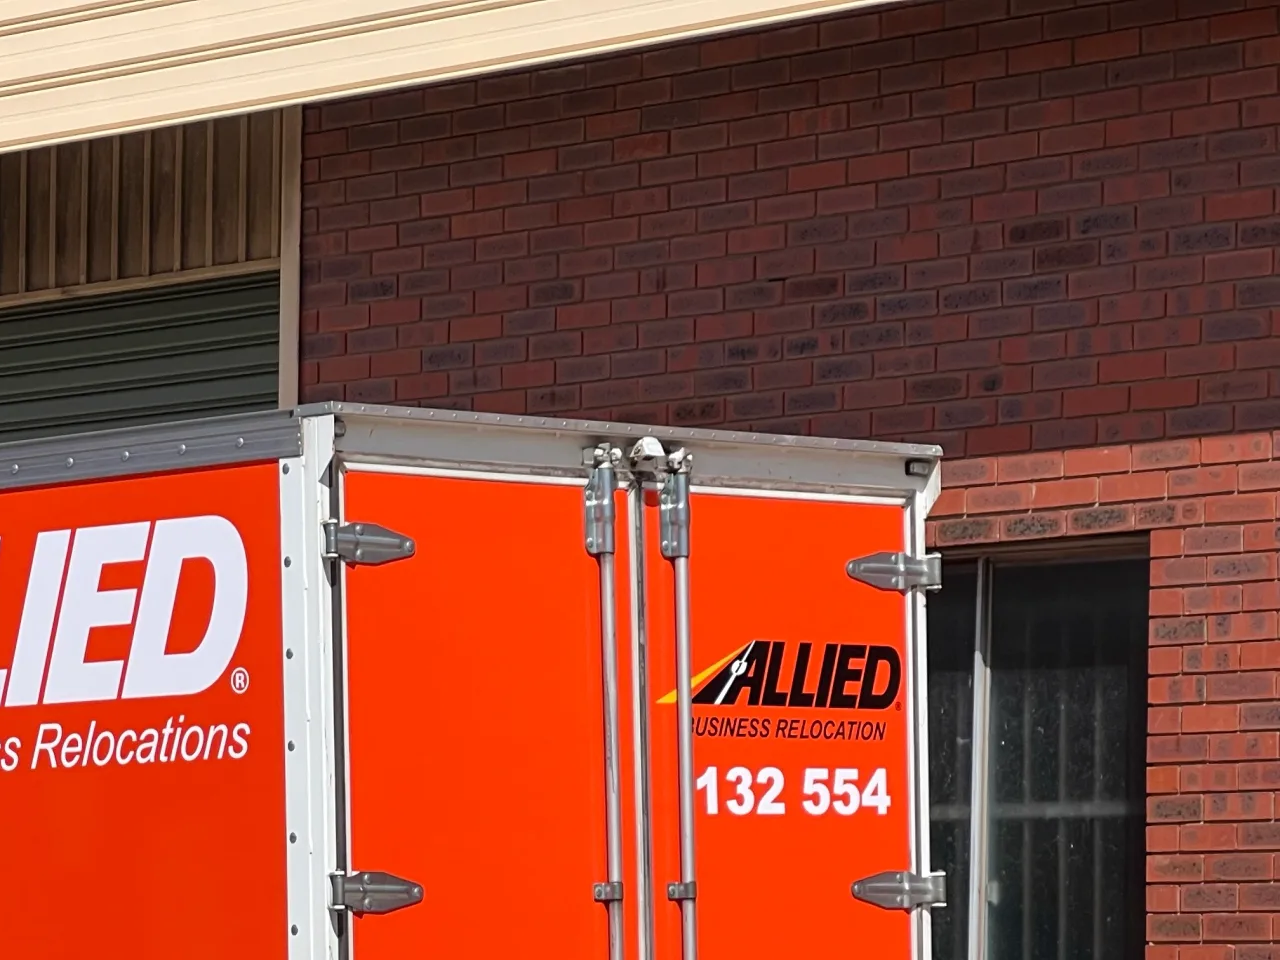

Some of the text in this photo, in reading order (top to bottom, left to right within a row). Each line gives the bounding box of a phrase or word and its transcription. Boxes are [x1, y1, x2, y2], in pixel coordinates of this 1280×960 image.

[714, 639, 902, 710] ALLIED
[31, 715, 251, 770] Relocations
[775, 719, 887, 741] RELOCATION
[696, 766, 891, 815] 132 554
